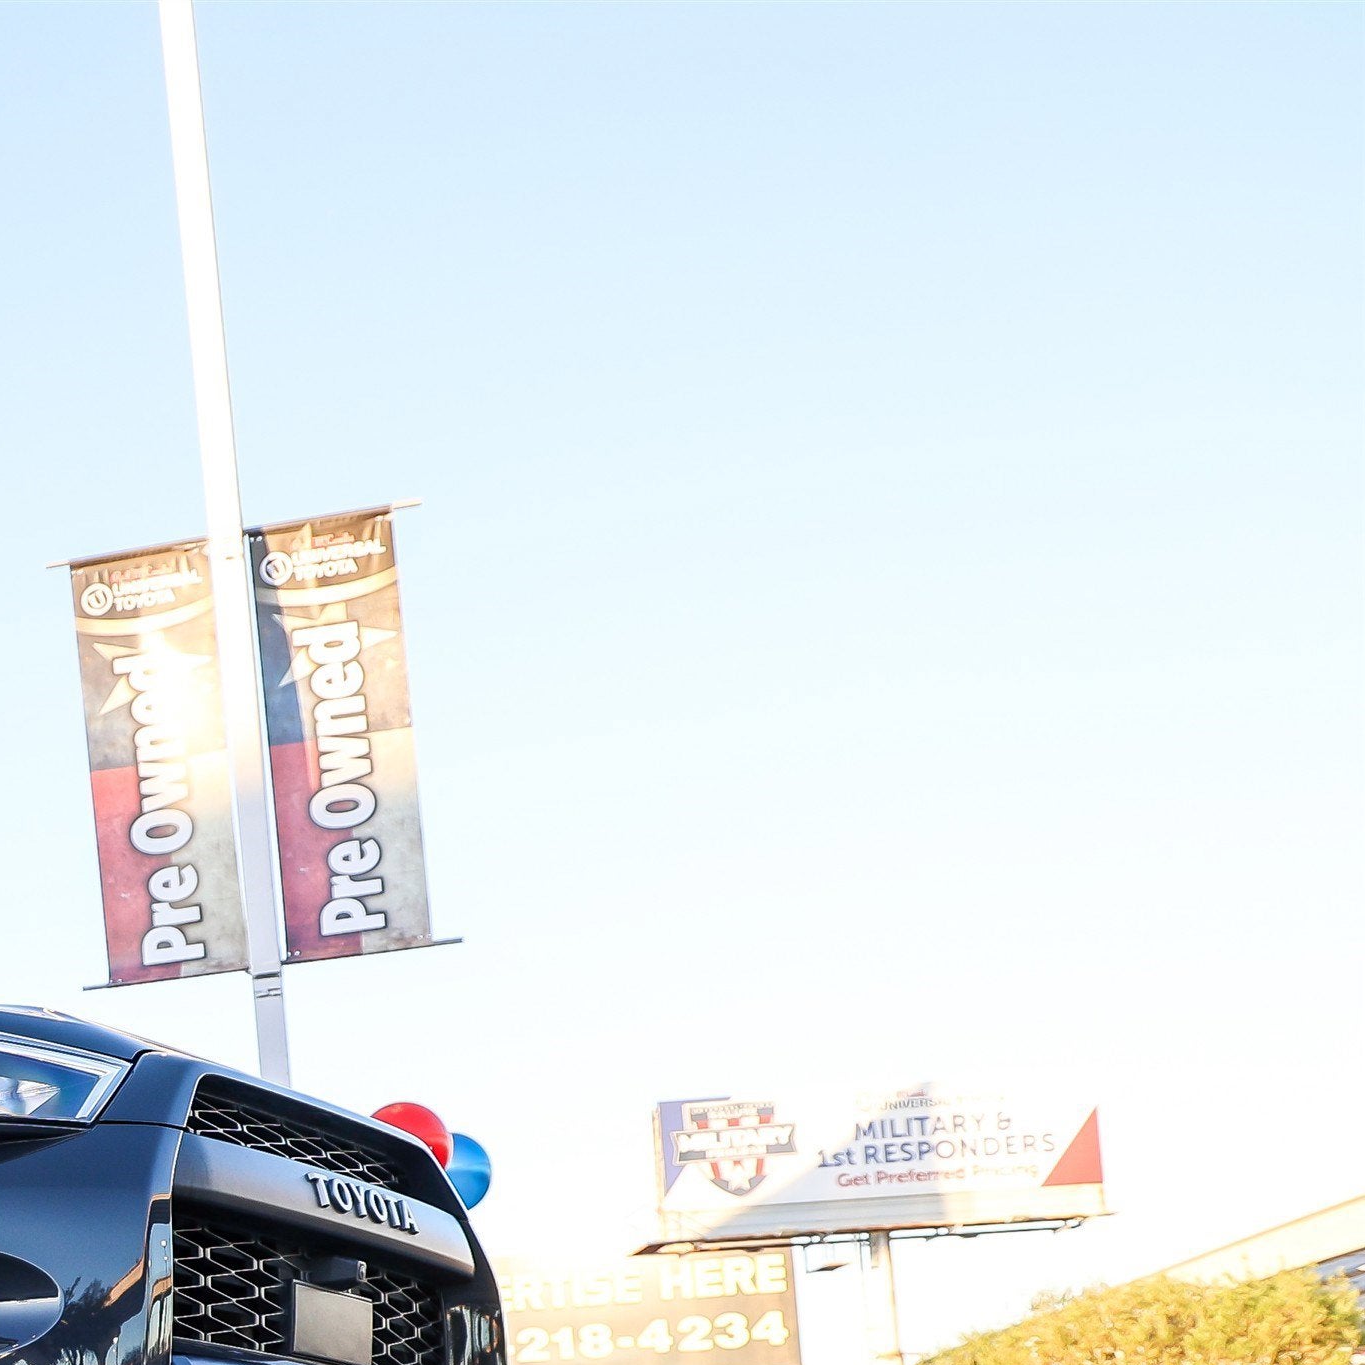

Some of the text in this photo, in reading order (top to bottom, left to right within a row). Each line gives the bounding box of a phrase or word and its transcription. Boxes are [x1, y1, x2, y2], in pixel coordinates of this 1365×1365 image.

[293, 558, 359, 582] TOYOTA
[292, 620, 378, 830] Owned
[320, 838, 388, 937] Pre
[142, 862, 207, 967] Pre
[855, 1111, 1012, 1141] MILITARY &
[817, 1133, 1056, 1168] 1st RESPONDERS
[836, 1171, 871, 1188] Get
[877, 1167, 965, 1185] Preferred
[307, 1172, 421, 1235] TOYOTA
[659, 1252, 788, 1300] HERE
